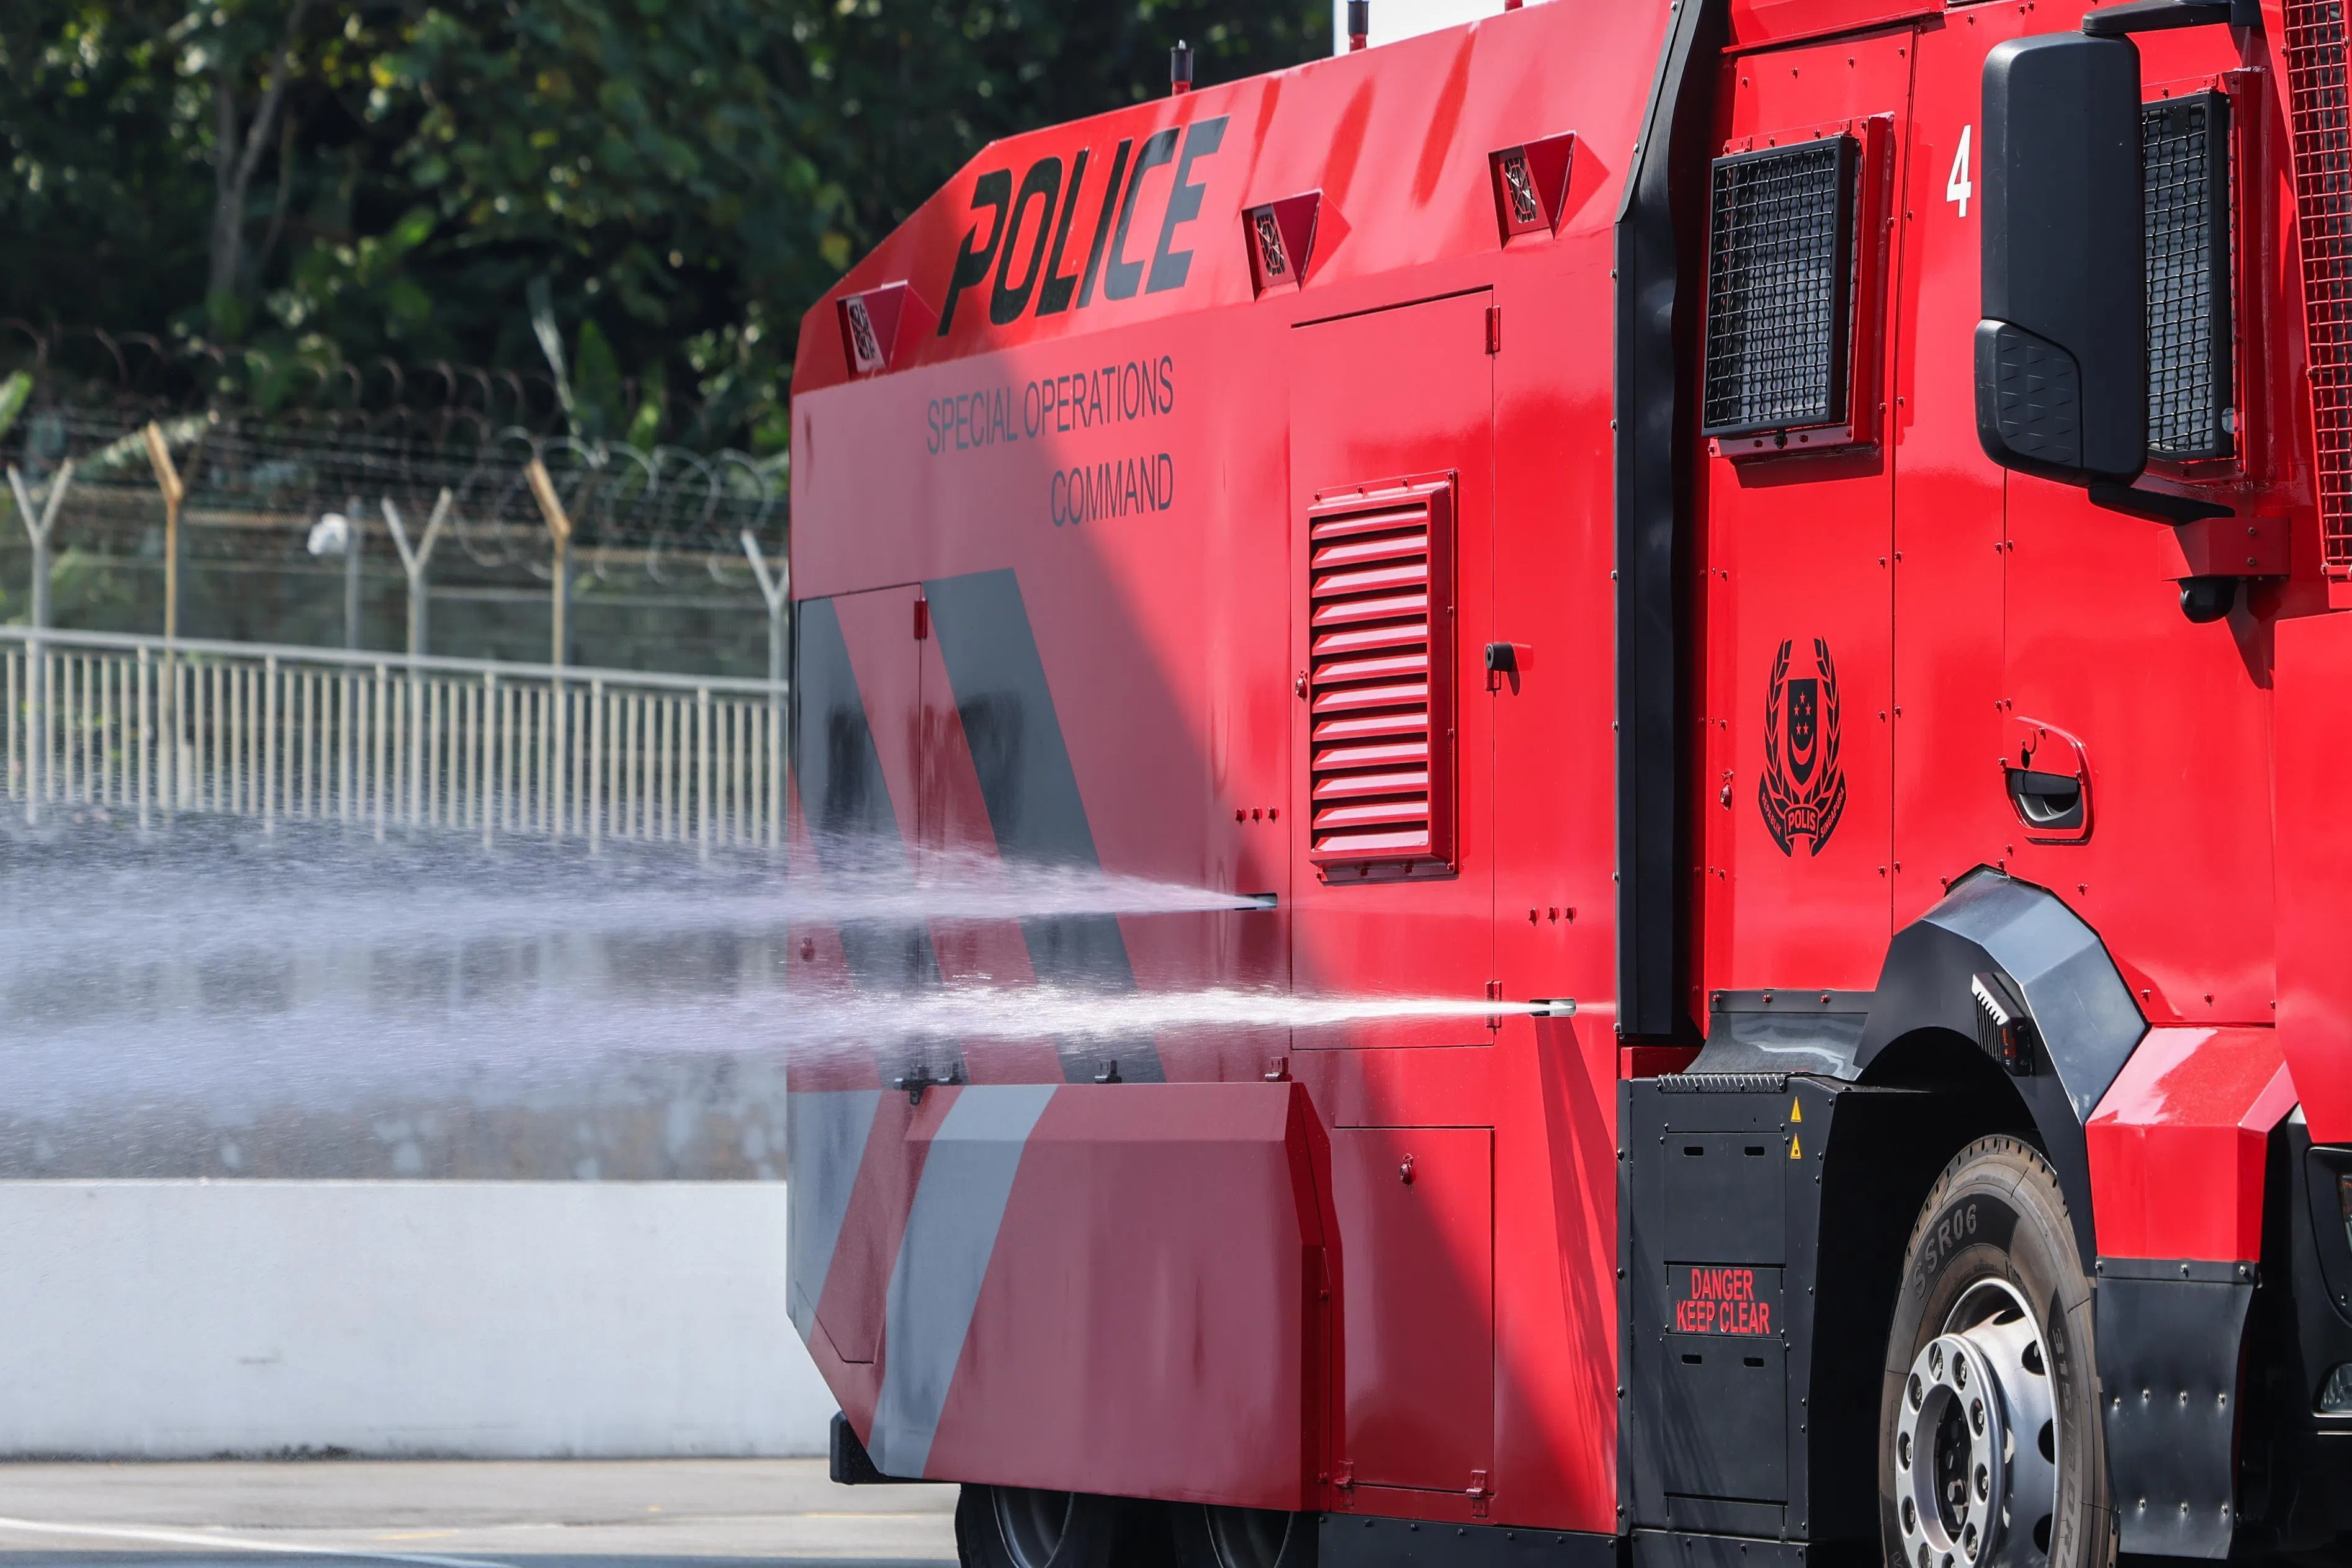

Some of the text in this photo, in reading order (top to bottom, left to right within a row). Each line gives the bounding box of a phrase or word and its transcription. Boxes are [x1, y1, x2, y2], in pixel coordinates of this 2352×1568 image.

[1946, 124, 1972, 218] 4
[936, 114, 1230, 337] POLICE
[927, 355, 1174, 455] SPECIAL OPERATIONS
[1051, 452, 1174, 527] COMMAND
[1788, 809, 1816, 832] POLIS
[1820, 786, 1844, 838] SINGAPURA
[1691, 1268, 1754, 1301] DANGER
[1913, 1204, 1977, 1299] SSR06
[1677, 1301, 1771, 1334] KEEP CLEAR
